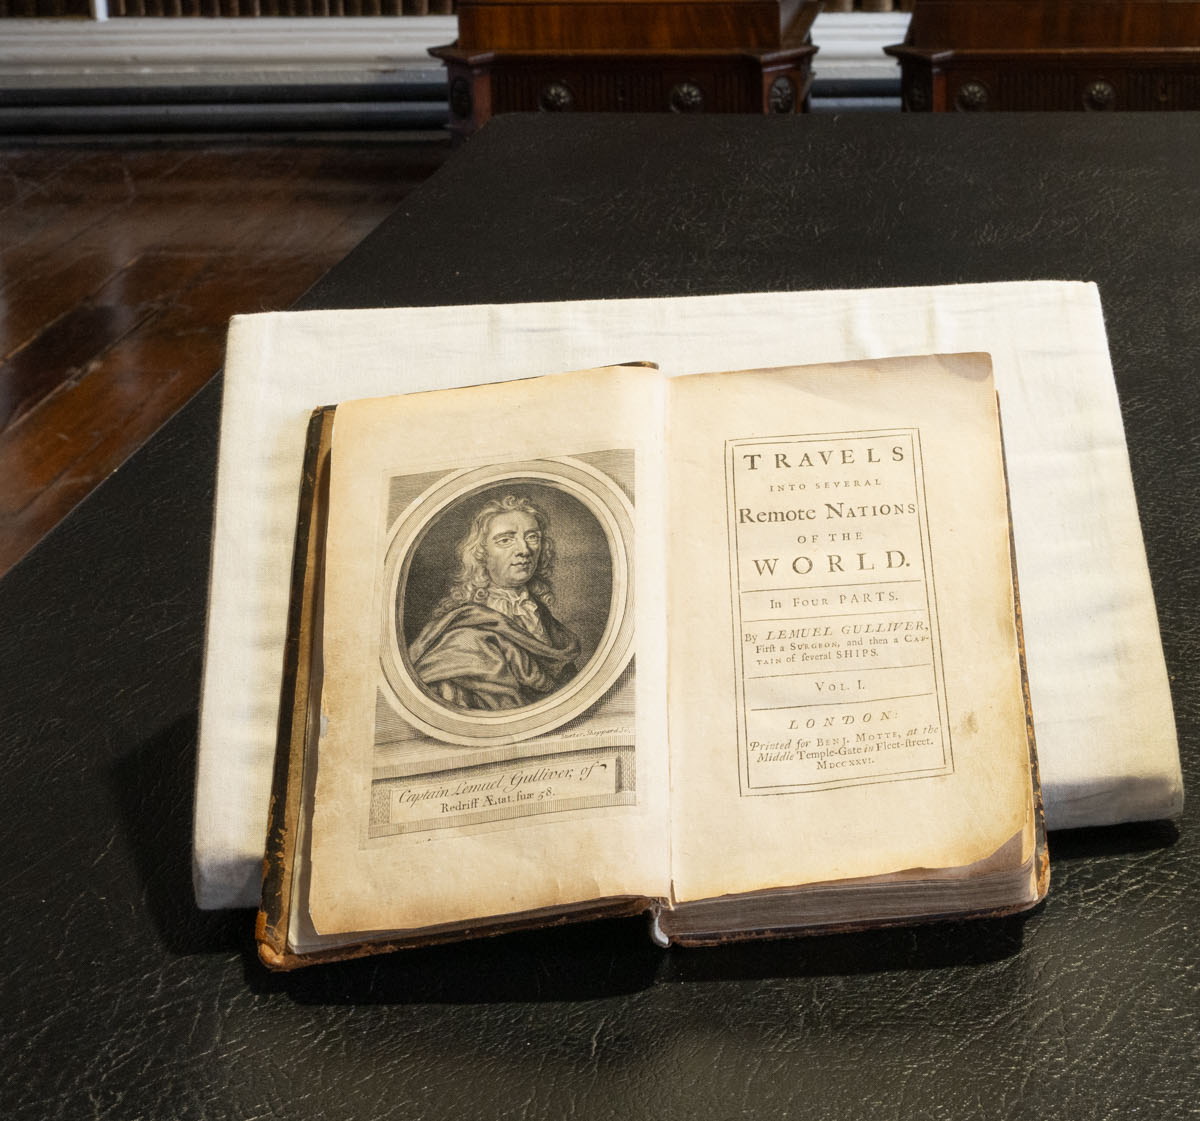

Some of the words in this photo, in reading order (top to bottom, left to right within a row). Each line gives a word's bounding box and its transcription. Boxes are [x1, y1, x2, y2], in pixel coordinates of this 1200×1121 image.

[743, 446, 904, 470] TRAVELS
[769, 483, 806, 492] INTO
[815, 479, 882, 489] SEVERAL
[739, 508, 817, 524] Remote
[825, 502, 916, 520] NATIONS
[797, 534, 819, 544] OF
[828, 531, 864, 541] THE
[752, 550, 911, 577] WORLD.
[770, 599, 782, 609] In
[793, 597, 829, 608] FOUR
[839, 591, 899, 604] PARTS.
[745, 633, 758, 644] By
[766, 626, 833, 641] LEMUEL
[841, 621, 929, 635] GULLIVER,
[847, 637, 863, 646] and
[869, 636, 888, 645] then
[786, 653, 796, 663] of
[836, 648, 878, 659] SHIPS.
[857, 679, 865, 690] I.
[749, 739, 792, 751] Printed
[795, 738, 811, 750] for
[856, 731, 901, 743] MOTTE,
[906, 727, 917, 737] at
[922, 724, 939, 734] the
[756, 751, 794, 763] Middle
[796, 746, 863, 760] Temple-Gate
[864, 744, 874, 753] in
[398, 786, 449, 808] Captain
[451, 775, 505, 796] Lemuel
[503, 768, 574, 793] Gulliver,
[579, 761, 607, 781] of
[440, 797, 480, 813] Redriff
